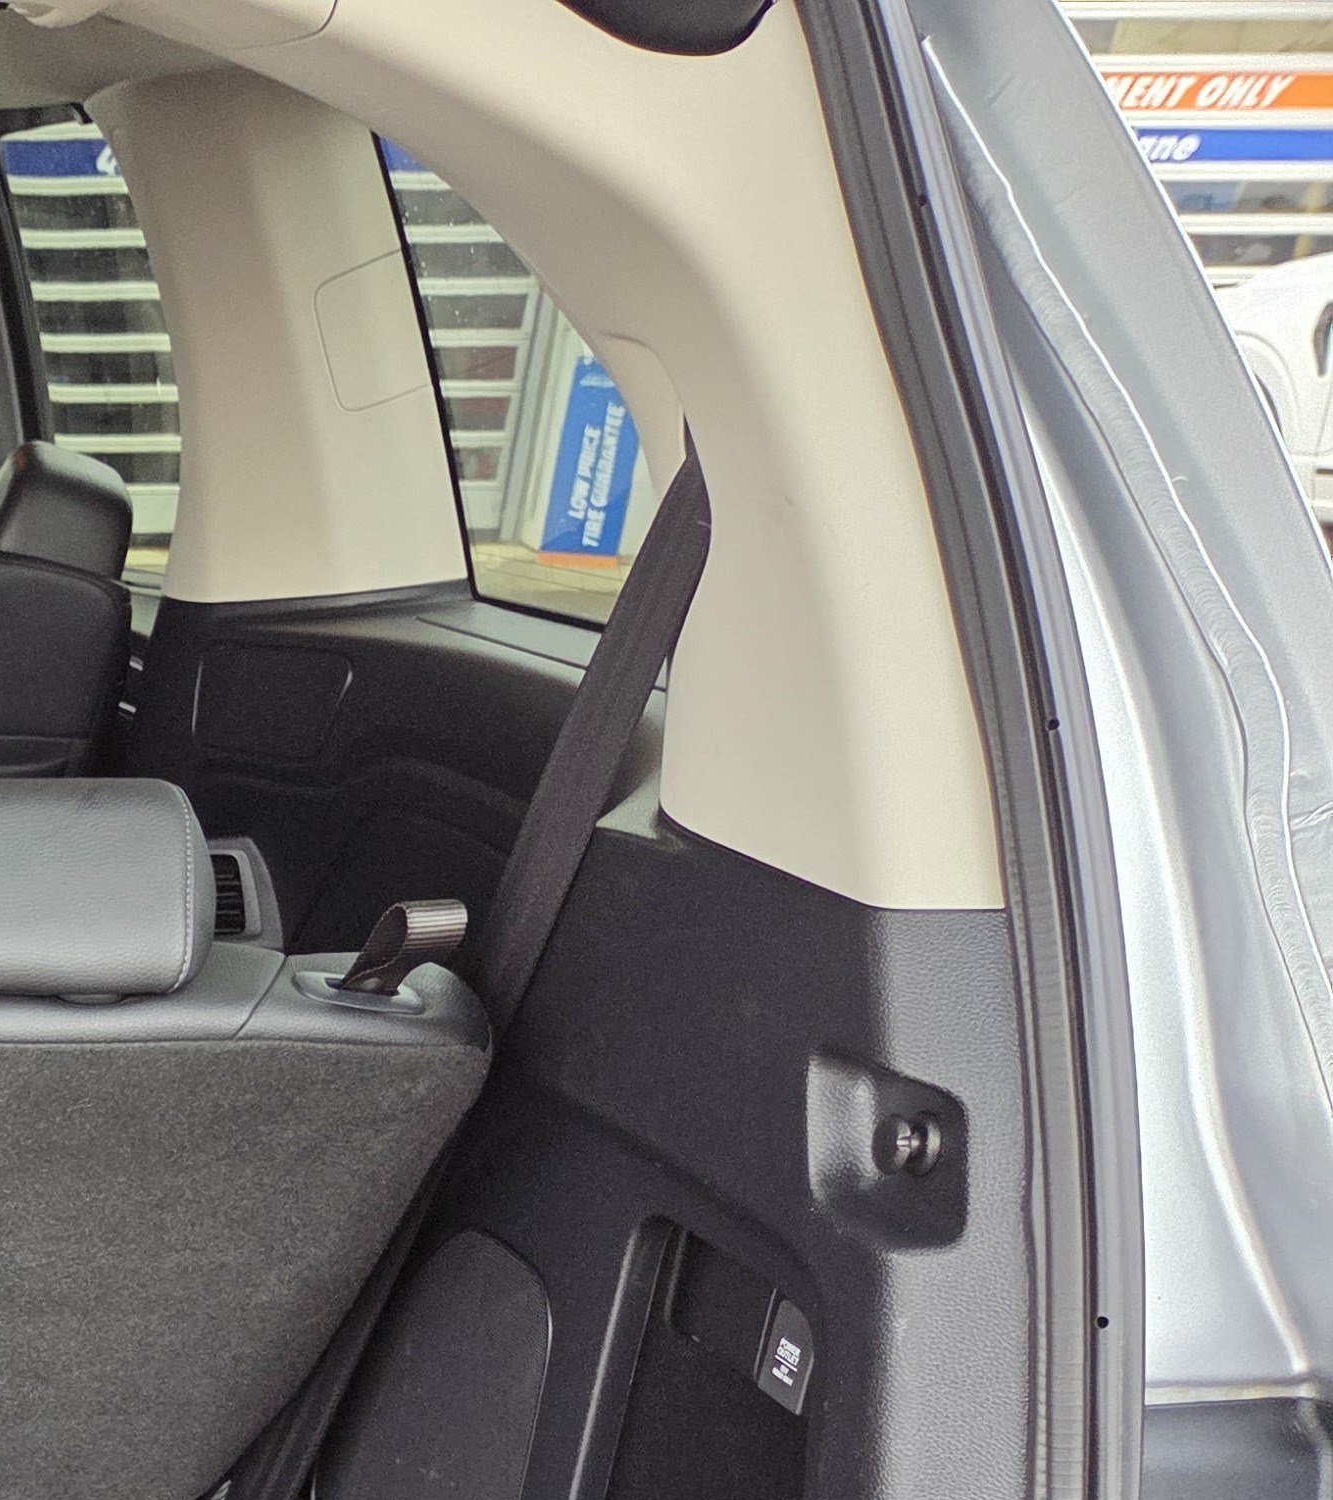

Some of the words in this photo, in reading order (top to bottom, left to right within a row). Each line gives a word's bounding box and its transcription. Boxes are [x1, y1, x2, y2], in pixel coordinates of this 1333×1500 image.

[1196, 75, 1297, 108] ONLY
[567, 479, 590, 520] LOW
[582, 508, 606, 547] TIRE
